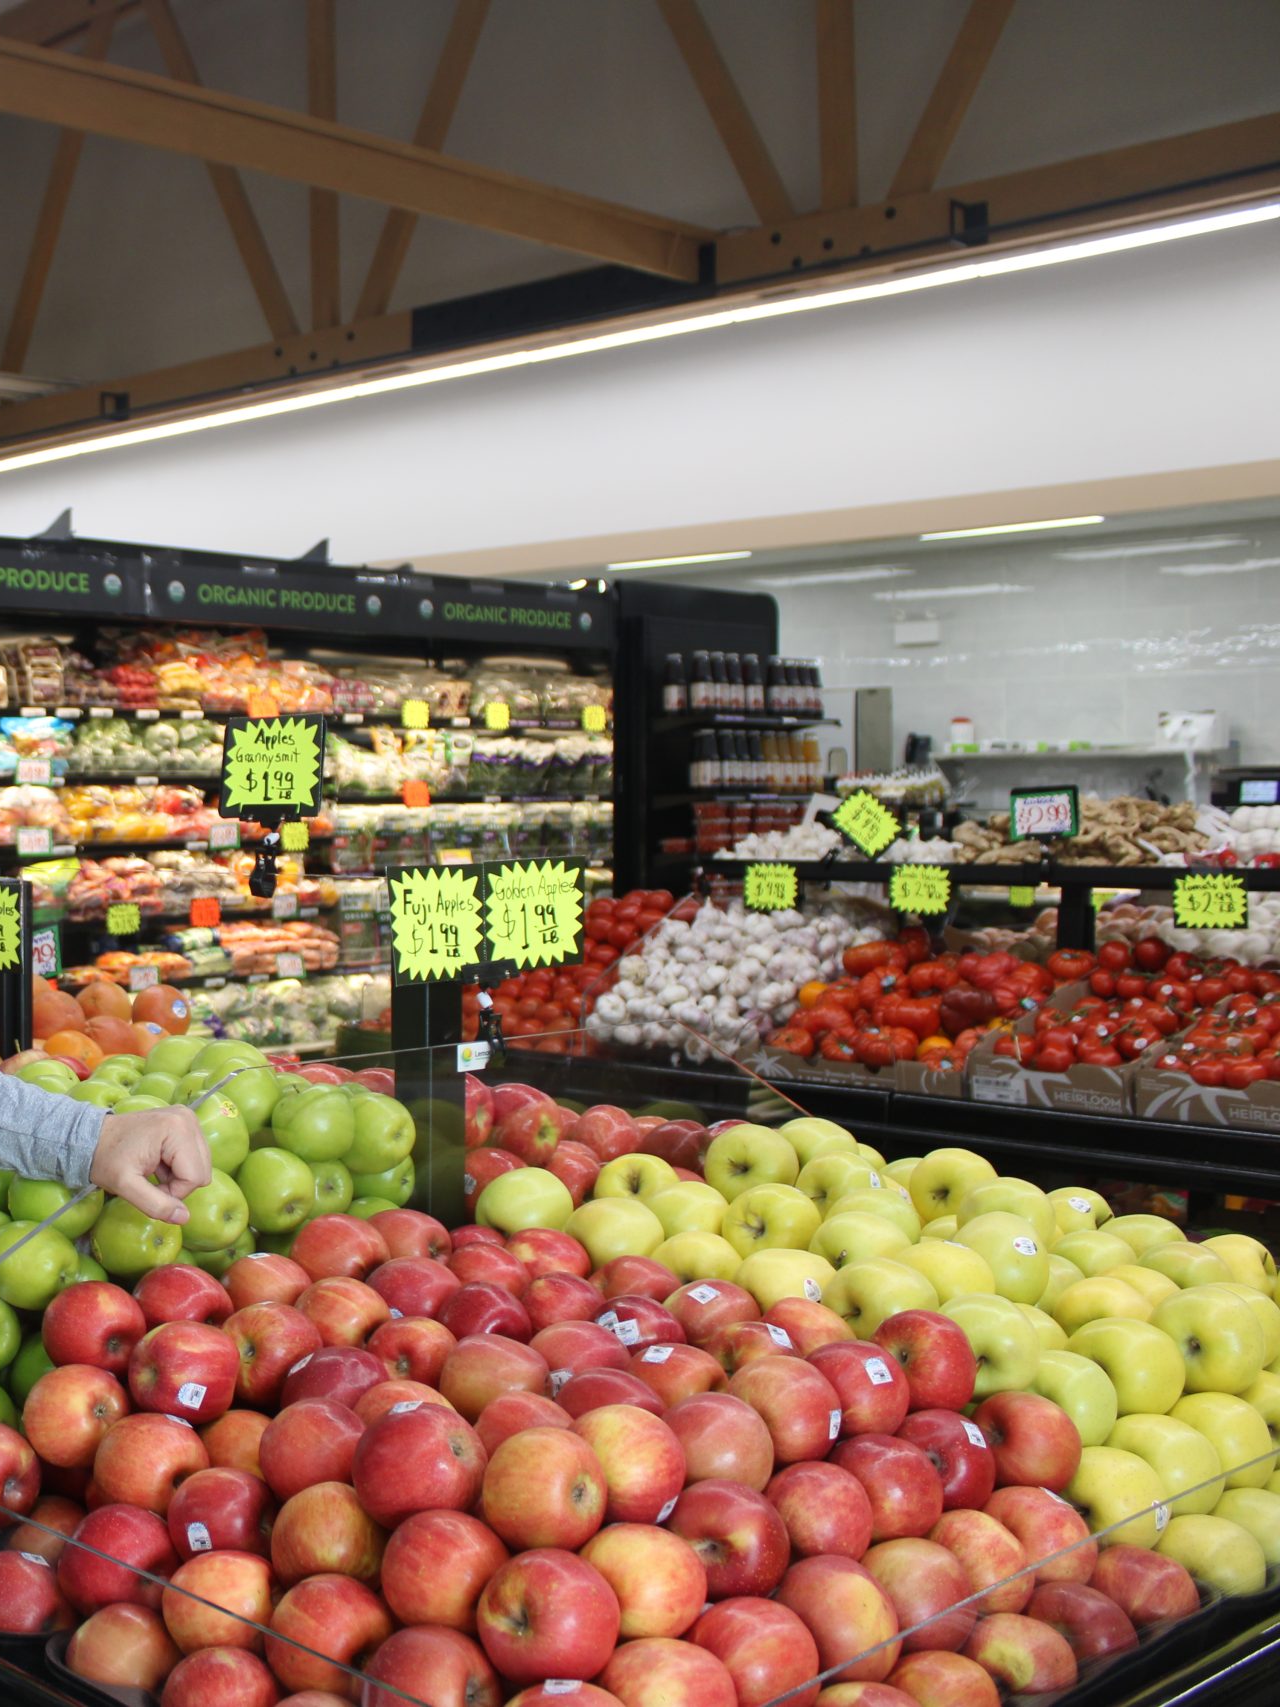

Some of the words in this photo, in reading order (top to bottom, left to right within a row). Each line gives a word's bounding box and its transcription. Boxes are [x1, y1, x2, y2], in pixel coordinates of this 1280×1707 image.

[197, 583, 277, 608] ORGANIC
[280, 590, 357, 614] PRODUCE
[442, 603, 507, 624] ORGANIC
[510, 608, 572, 629] PRODUCE
[254, 728, 295, 750] Apples
[538, 875, 576, 902] Apples
[403, 889, 431, 925] Fuji
[436, 889, 474, 918] Apples
[543, 930, 559, 944] LB
[446, 947, 461, 957] LB
